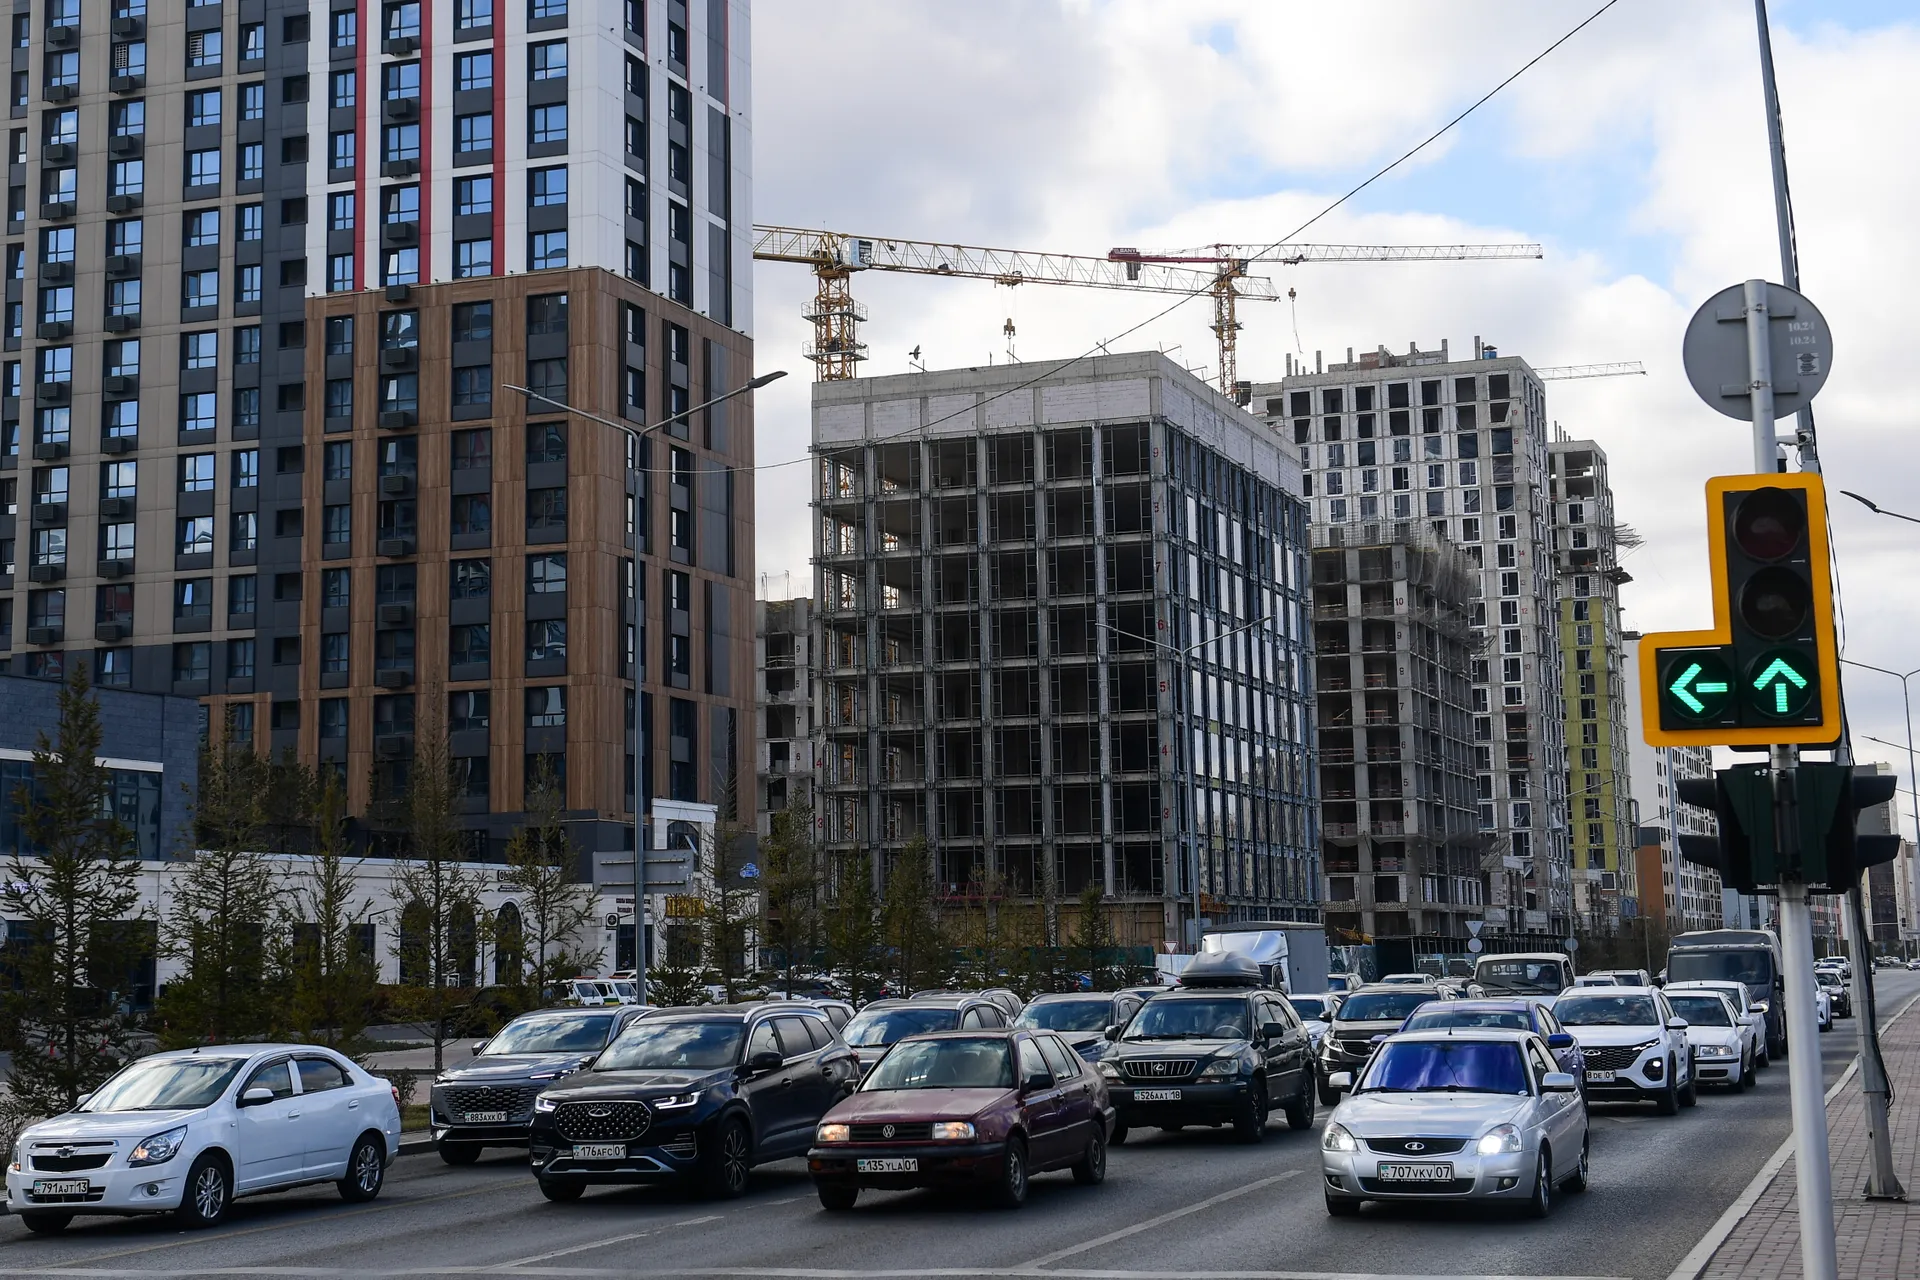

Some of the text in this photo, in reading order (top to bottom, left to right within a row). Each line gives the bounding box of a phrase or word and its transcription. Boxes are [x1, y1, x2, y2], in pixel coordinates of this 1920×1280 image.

[1153, 447, 1159, 458] 9
[1395, 597, 1404, 606] 10
[1157, 619, 1164, 630] 6
[1159, 681, 1166, 693] 5
[1162, 744, 1168, 756] 4
[816, 757, 822, 768] 4
[1605, 1071, 1614, 1079] 01
[1171, 1091, 1180, 1099] 18
[470, 1112, 507, 1121] 883AXK 01
[580, 1146, 626, 1156] 176AFC 01
[905, 1160, 917, 1170] 01
[1391, 1166, 1450, 1178] 707VKV 07
[41, 1181, 87, 1193] 791AJT 13
